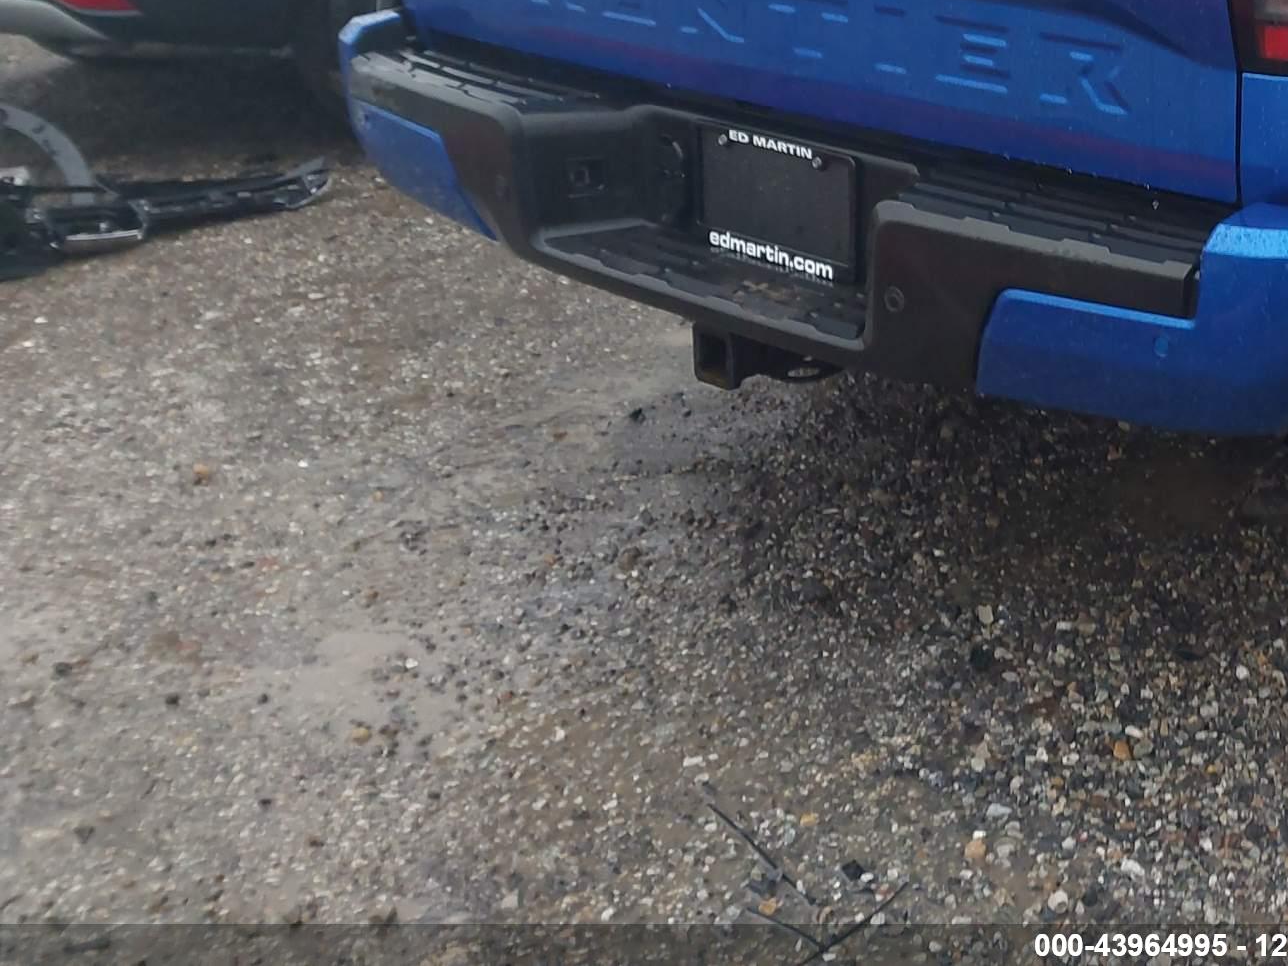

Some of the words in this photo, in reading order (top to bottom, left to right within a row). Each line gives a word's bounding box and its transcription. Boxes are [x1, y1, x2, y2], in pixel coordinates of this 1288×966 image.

[728, 129, 750, 144] ED
[752, 135, 813, 160] MARTIN
[709, 231, 834, 280] edmartin.com
